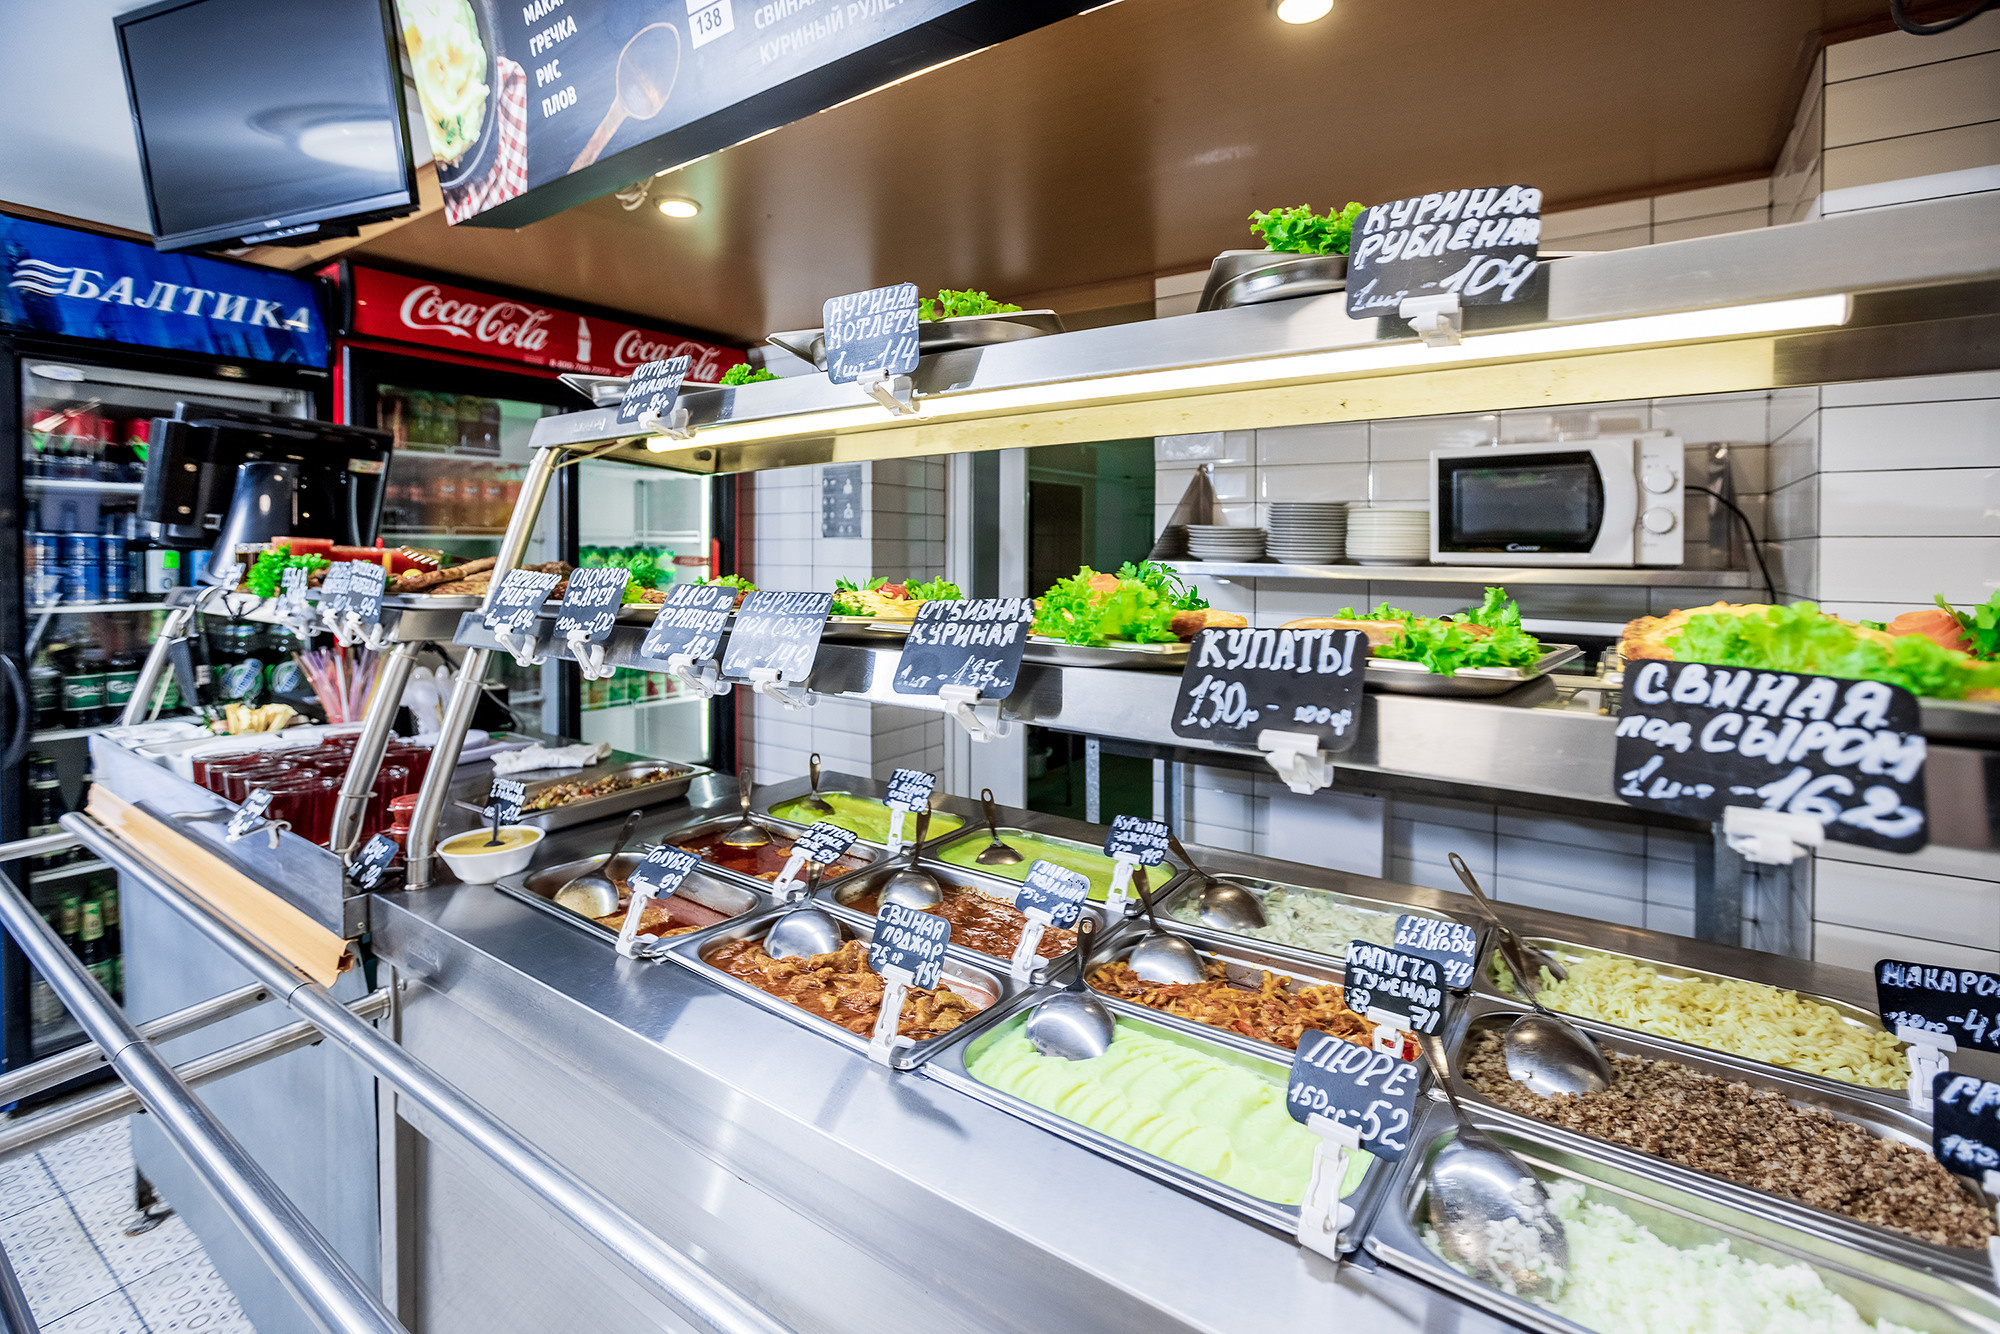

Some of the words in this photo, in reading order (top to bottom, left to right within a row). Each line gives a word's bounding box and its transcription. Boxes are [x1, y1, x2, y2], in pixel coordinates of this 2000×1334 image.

[523, 0, 564, 26] МАКА
[695, 7, 723, 35] 138
[529, 15, 578, 57] ГРЕЧКА
[759, 4, 844, 65] КУРИНЫЙ
[535, 59, 562, 88] РИС
[541, 85, 578, 118] ПЛОВ
[1363, 185, 1542, 235] КУРИНАЯ
[1353, 217, 1541, 270] РУБЛЕНАЯ
[62, 267, 311, 333] БАЛТИКА
[400, 285, 553, 351] Coca-Cola
[829, 285, 919, 325] КУРИНАЯ
[828, 308, 919, 351] КОТЛЕТА
[496, 586, 543, 607] РУЛЕТ
[667, 584, 718, 607] МЯСО
[746, 591, 832, 615] КУРИНАЯ
[917, 598, 1034, 623] ОТБИВНАЯ
[655, 607, 729, 634] ФРАНЦУЗ
[908, 622, 1019, 647] КУРИНАЯ
[682, 635, 716, 660] 162
[1196, 628, 1361, 677] КУПАТЫ
[1633, 662, 1894, 729] СВИНАЯ
[1700, 712, 1928, 783] СЫРОМ
[644, 846, 697, 877] ГОЛУБЕЦ
[658, 873, 683, 893] 99
[877, 904, 945, 940] СВИНАЯ
[1401, 915, 1472, 941] ГРИБЫ
[881, 925, 944, 962] ПОДЖАР
[914, 960, 941, 991] 154
[1345, 942, 1438, 986] КАПУСТА
[1443, 959, 1475, 985] 74
[1881, 962, 2000, 998] МАКАРО
[1350, 967, 1441, 1008] ТУШЕНАЯ
[1408, 1004, 1441, 1034] 71
[1302, 1036, 1418, 1096] ПЮРЕ
[1940, 1076, 2000, 1121] ГР
